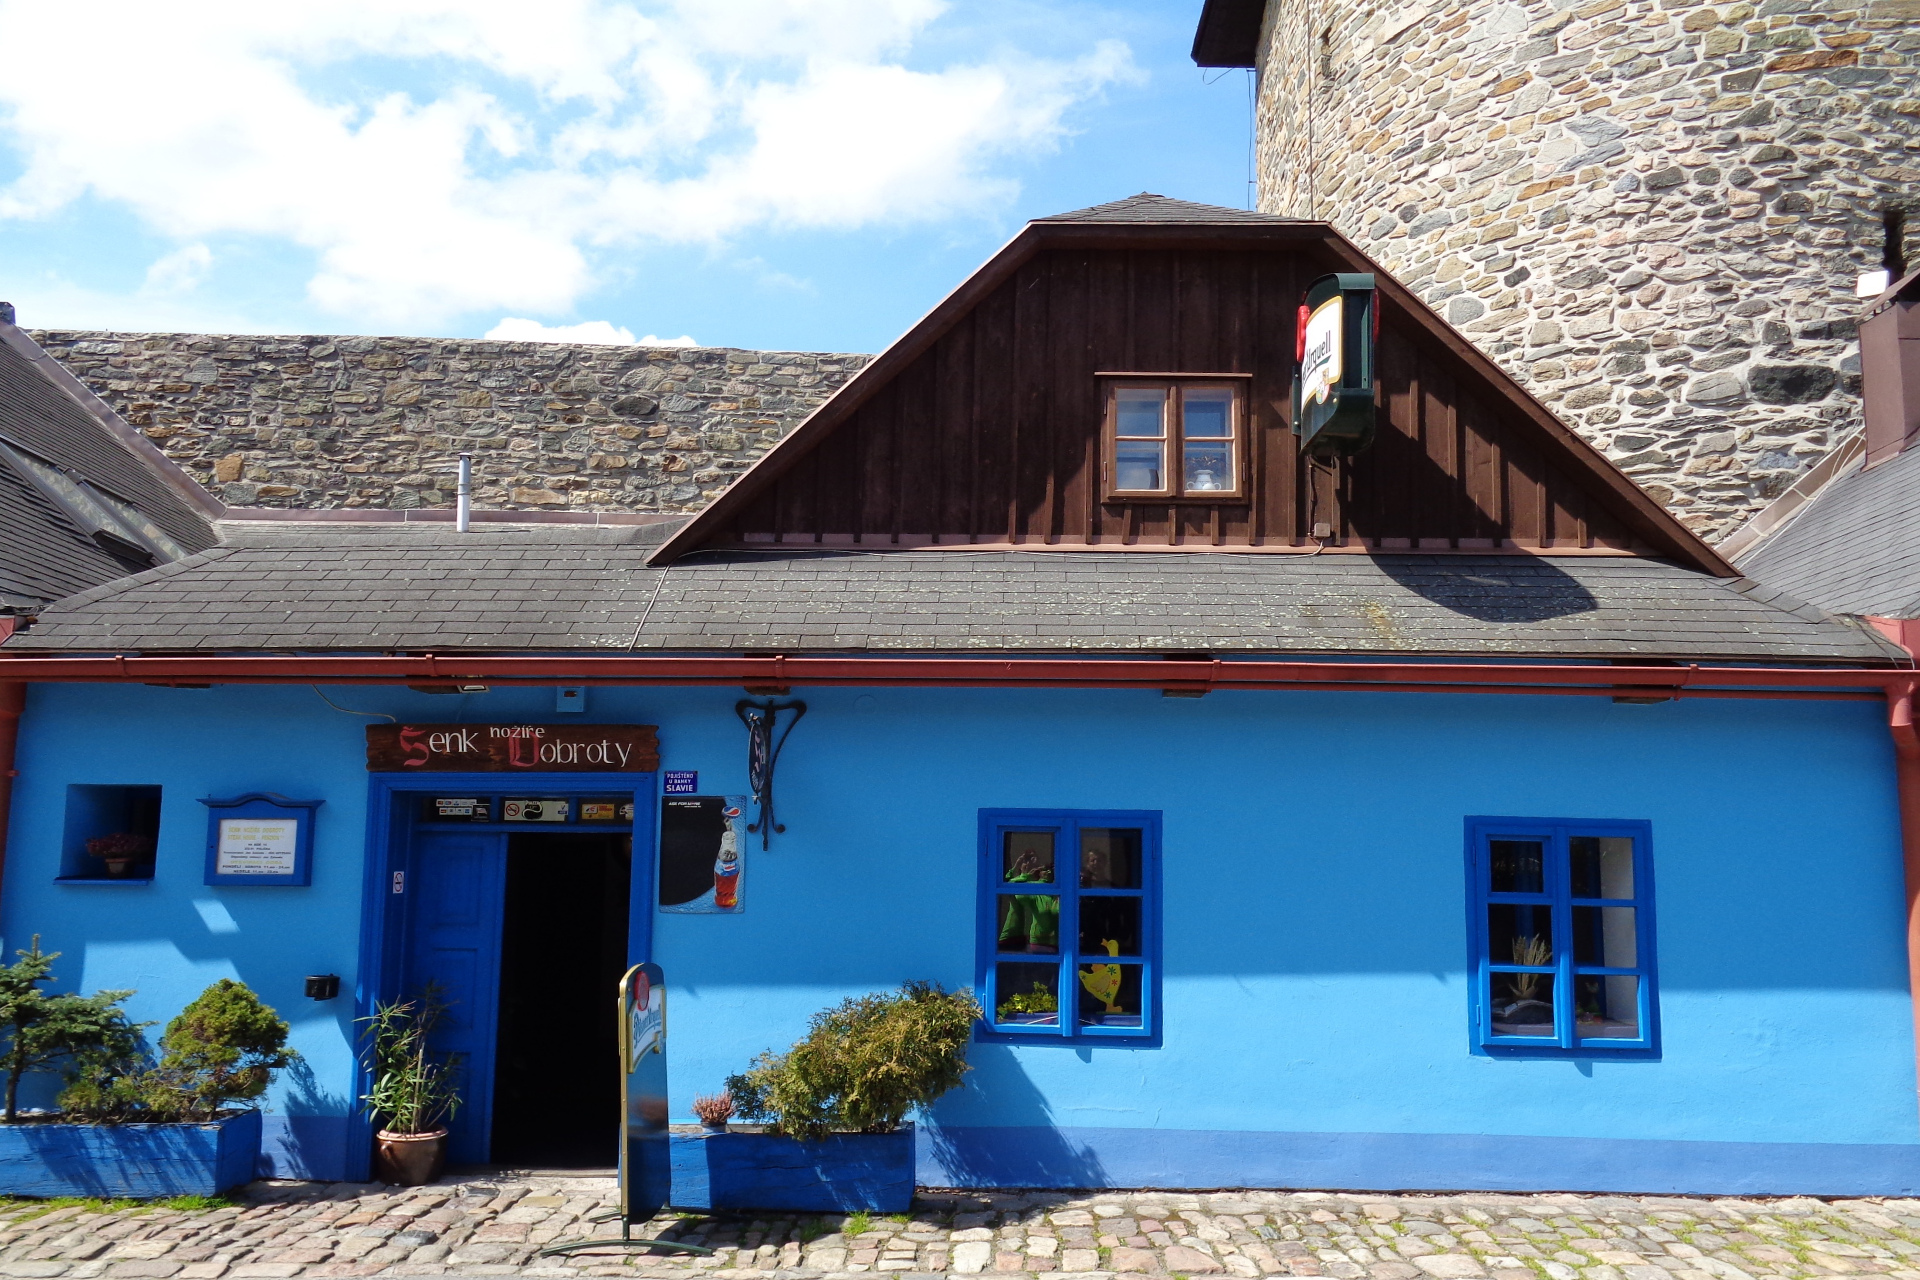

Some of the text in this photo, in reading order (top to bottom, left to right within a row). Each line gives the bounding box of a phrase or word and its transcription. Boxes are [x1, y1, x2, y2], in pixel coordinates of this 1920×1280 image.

[1306, 330, 1331, 373] Urquell
[490, 725, 546, 739] nožíře
[400, 726, 632, 768] Šenk Dobroty
[666, 784, 693, 792] SLAVIE
